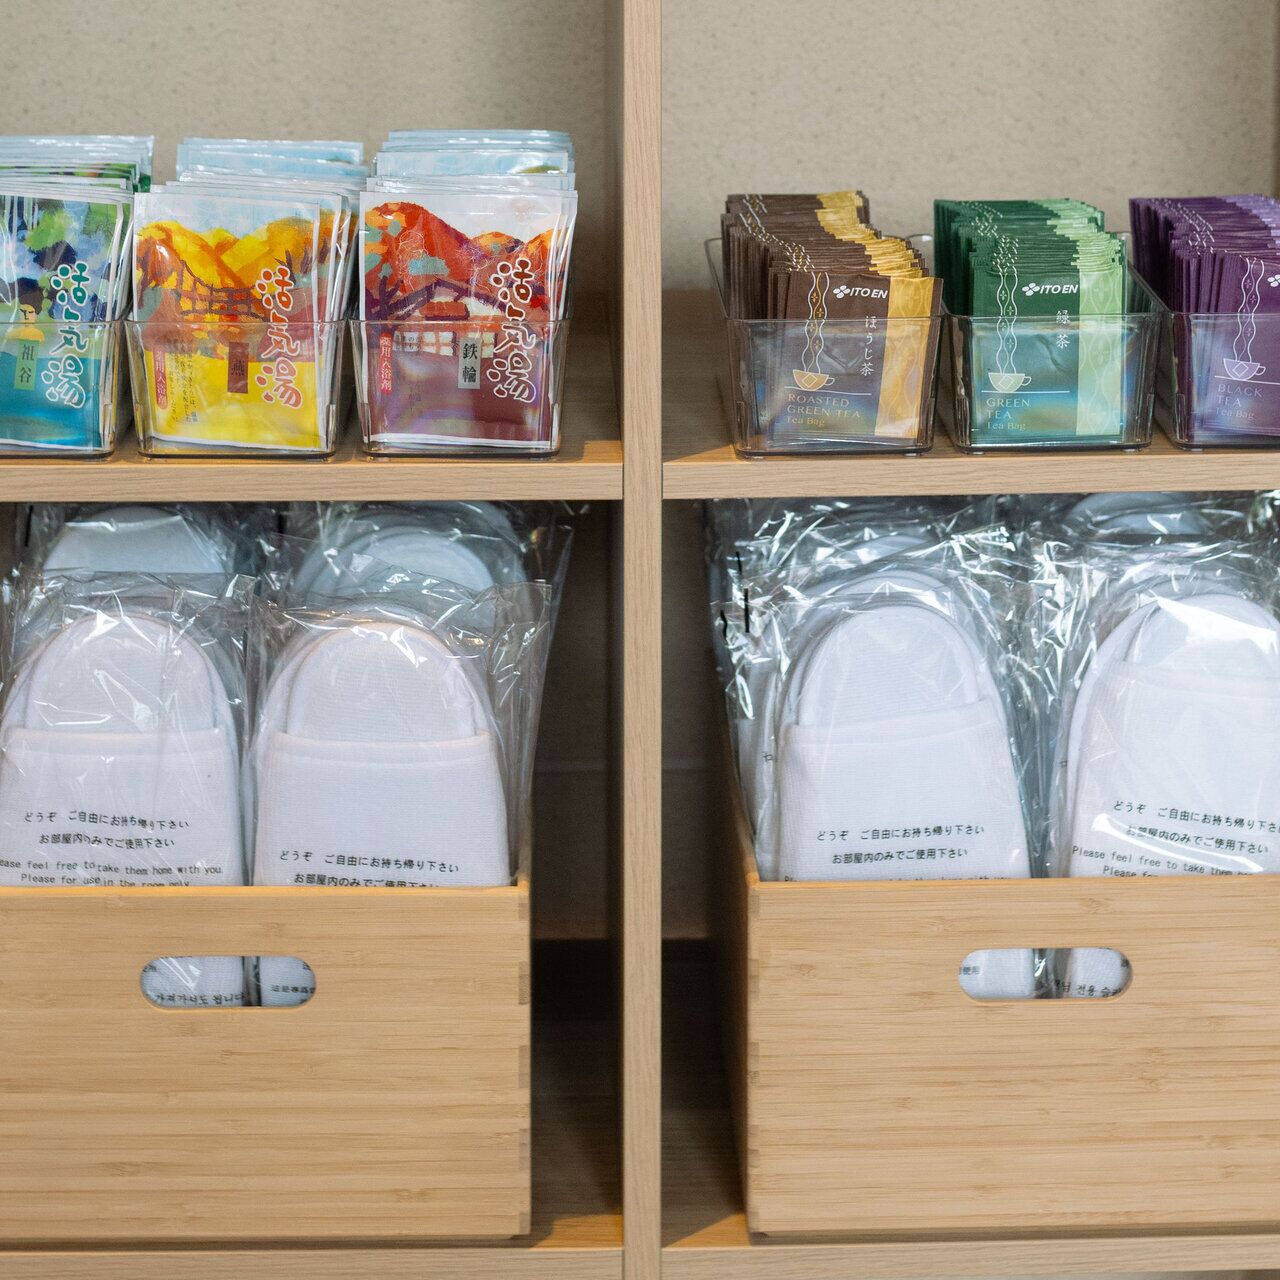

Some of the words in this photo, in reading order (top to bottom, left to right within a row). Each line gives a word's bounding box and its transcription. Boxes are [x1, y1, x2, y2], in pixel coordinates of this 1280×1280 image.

[849, 288, 870, 298] ITO
[871, 289, 888, 299] EN
[1039, 285, 1060, 294] ITO
[1062, 284, 1078, 294] EN
[41, 261, 91, 409] 活気湯
[486, 257, 537, 403] 活気湯
[1056, 309, 1070, 349] 緑茶
[255, 265, 302, 409] 活気湯
[860, 316, 877, 376] ほうじ茶
[18, 344, 35, 384] 祖谷
[380, 337, 391, 391] 薬用入浴剤
[462, 343, 477, 384] 鉄輪
[1218, 383, 1264, 398] BLACK
[788, 393, 850, 407] ROASTED
[986, 397, 1030, 408] GREEN
[1217, 395, 1242, 407] TEA
[787, 404, 831, 416] GREEN
[836, 409, 861, 418] TEA
[987, 410, 1012, 419] TEA
[1216, 409, 1232, 417] Tea
[1235, 410, 1255, 420] Bag
[807, 417, 825, 428] Bag
[1113, 800, 1146, 815] どうぞ
[25, 811, 56, 823] どうぞ
[817, 830, 849, 841] どうぞ
[860, 824, 984, 840] ご自由にお持ち帰り下さい
[280, 850, 313, 862] どうぞ
[325, 854, 459, 873] ご自由にお持ち帰り下さい
[832, 848, 968, 864] お部屋内のみでご使用下さい
[1072, 845, 1105, 860] Please
[1111, 850, 1132, 863] feel
[1139, 854, 1161, 868] free
[1166, 859, 1178, 870] to
[1183, 862, 1206, 874] take
[27, 860, 48, 869] feel
[56, 861, 78, 870] free
[84, 861, 96, 869] to
[97, 864, 119, 873] take
[125, 866, 148, 875] them
[152, 866, 172, 875] home
[177, 865, 200, 874] with
[1103, 865, 1137, 877] Please
[21, 873, 55, 883] Please
[62, 874, 77, 884] for
[83, 876, 100, 885] use
[103, 878, 114, 886] in
